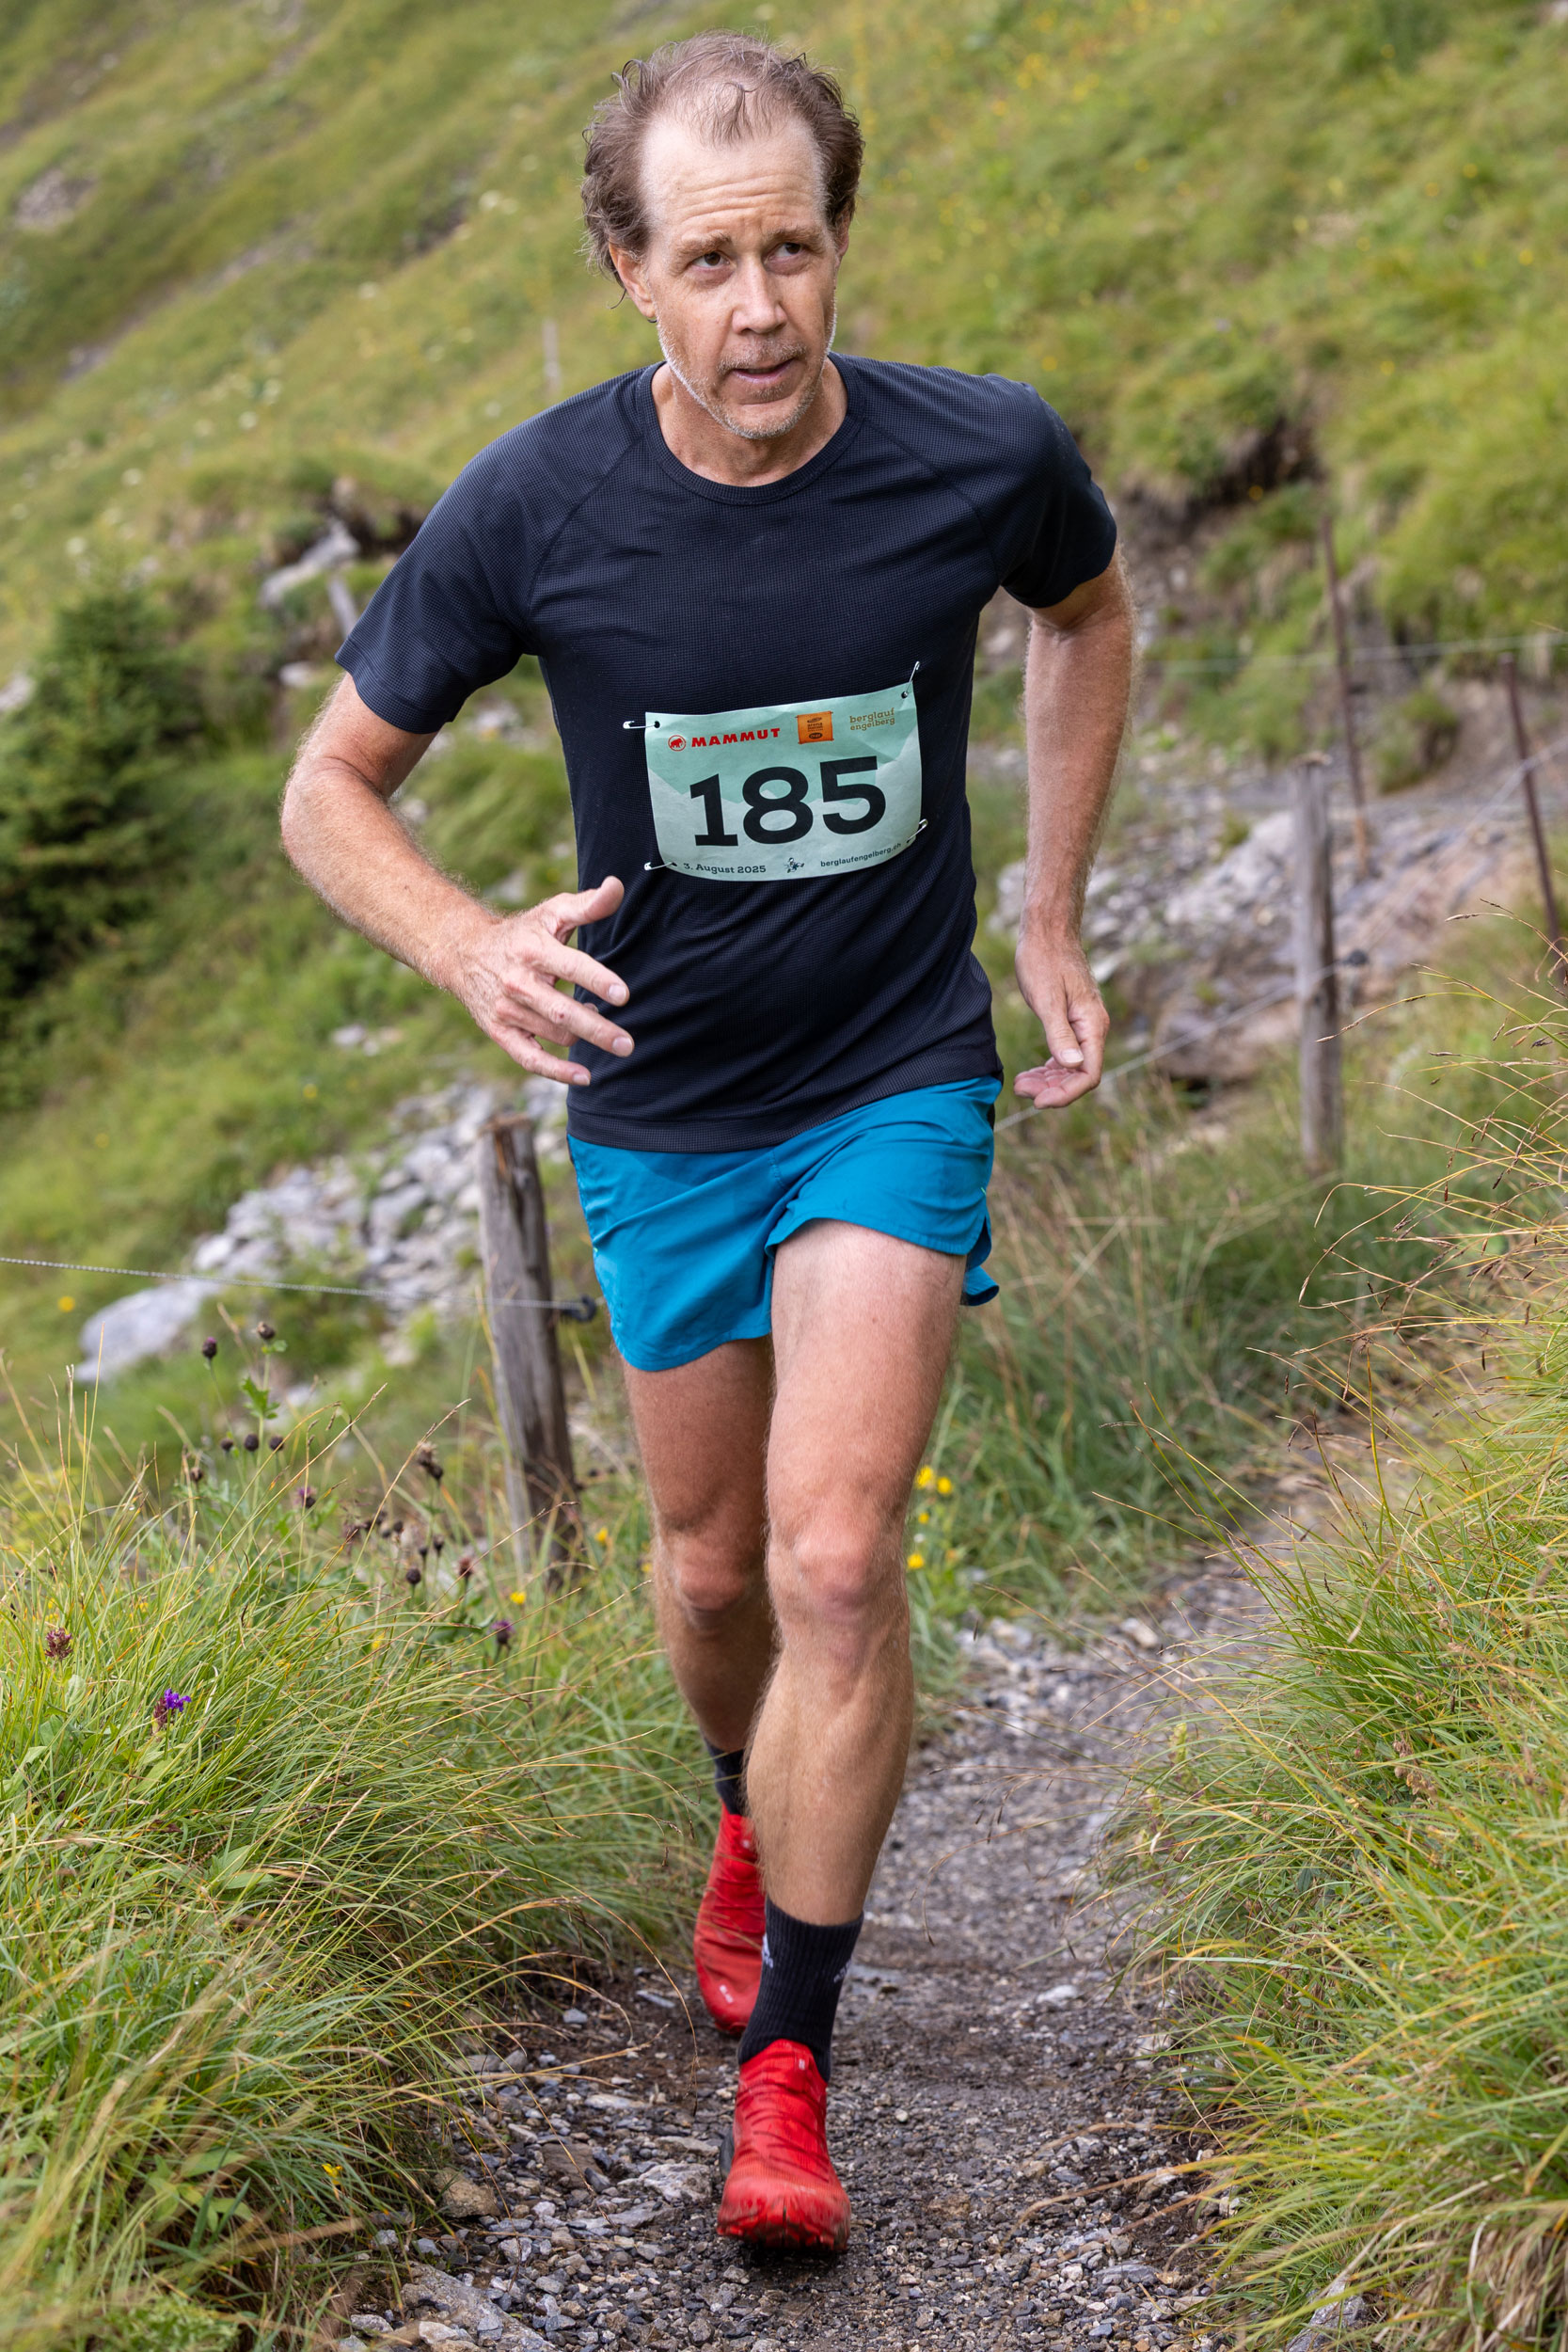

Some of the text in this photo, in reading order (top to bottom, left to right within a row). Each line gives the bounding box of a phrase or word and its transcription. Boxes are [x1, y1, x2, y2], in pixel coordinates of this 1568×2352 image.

[849, 707, 895, 723] berglauf
[850, 718, 895, 731] engelberg
[691, 728, 780, 747] MAMMUT
[689, 755, 886, 847] 185
[820, 843, 901, 866] berglaufengelberg.ch
[696, 864, 734, 874] August
